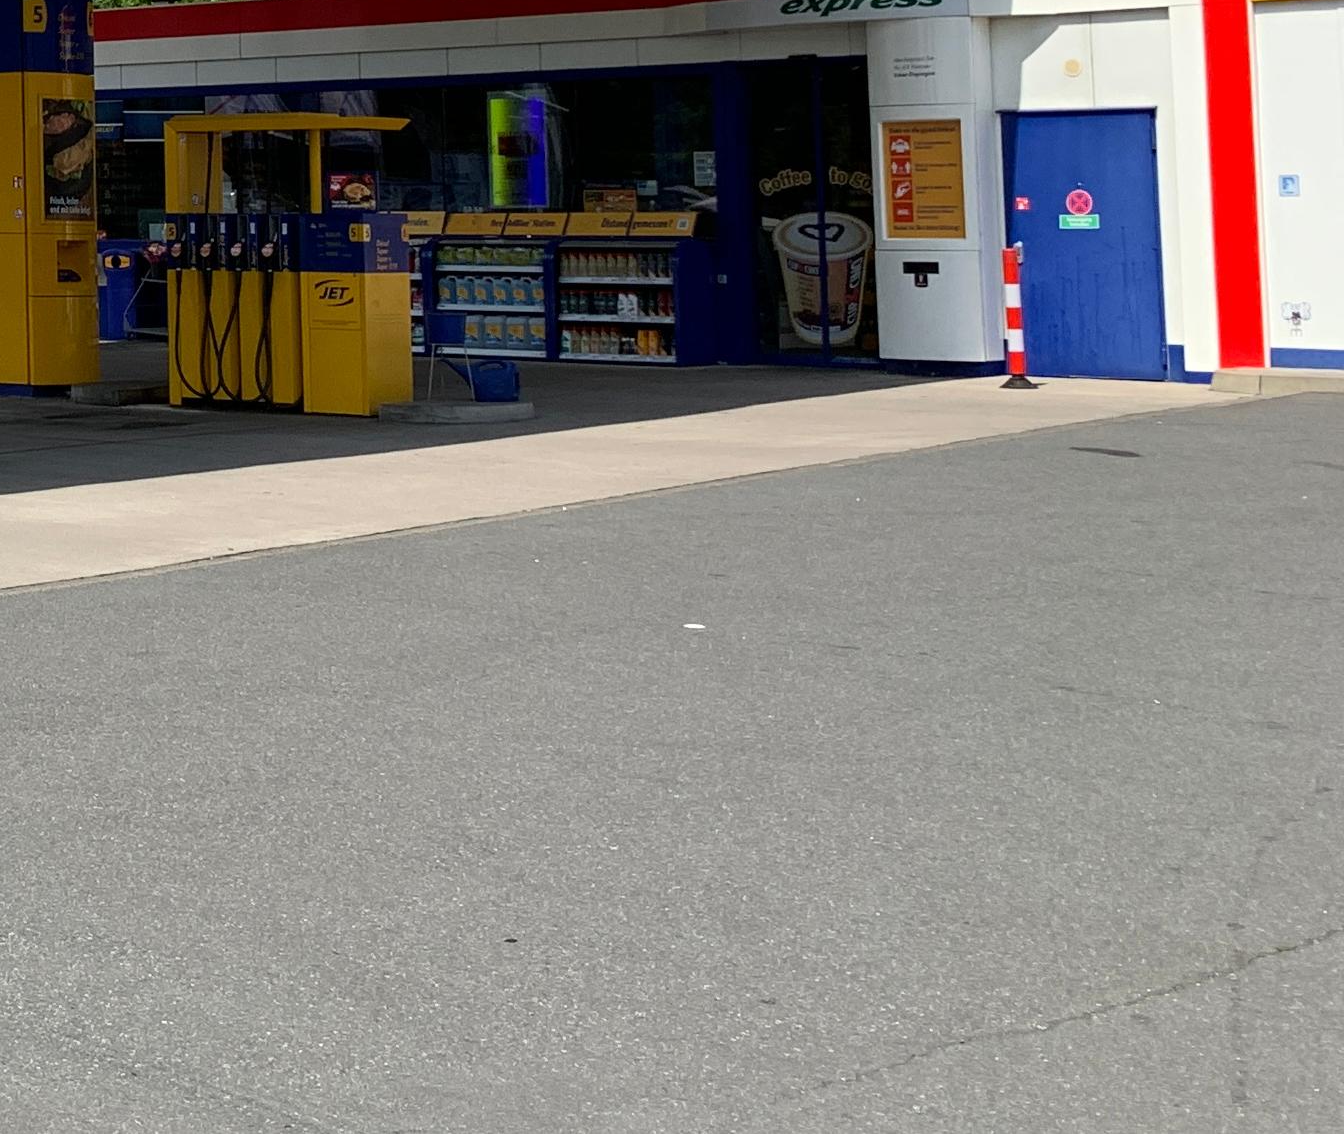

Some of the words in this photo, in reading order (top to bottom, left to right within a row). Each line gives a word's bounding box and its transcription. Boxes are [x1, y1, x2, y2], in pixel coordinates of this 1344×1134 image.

[33, 6, 43, 23] 5
[760, 168, 812, 196] Coffee
[829, 166, 848, 185] to
[319, 286, 350, 300] JET
